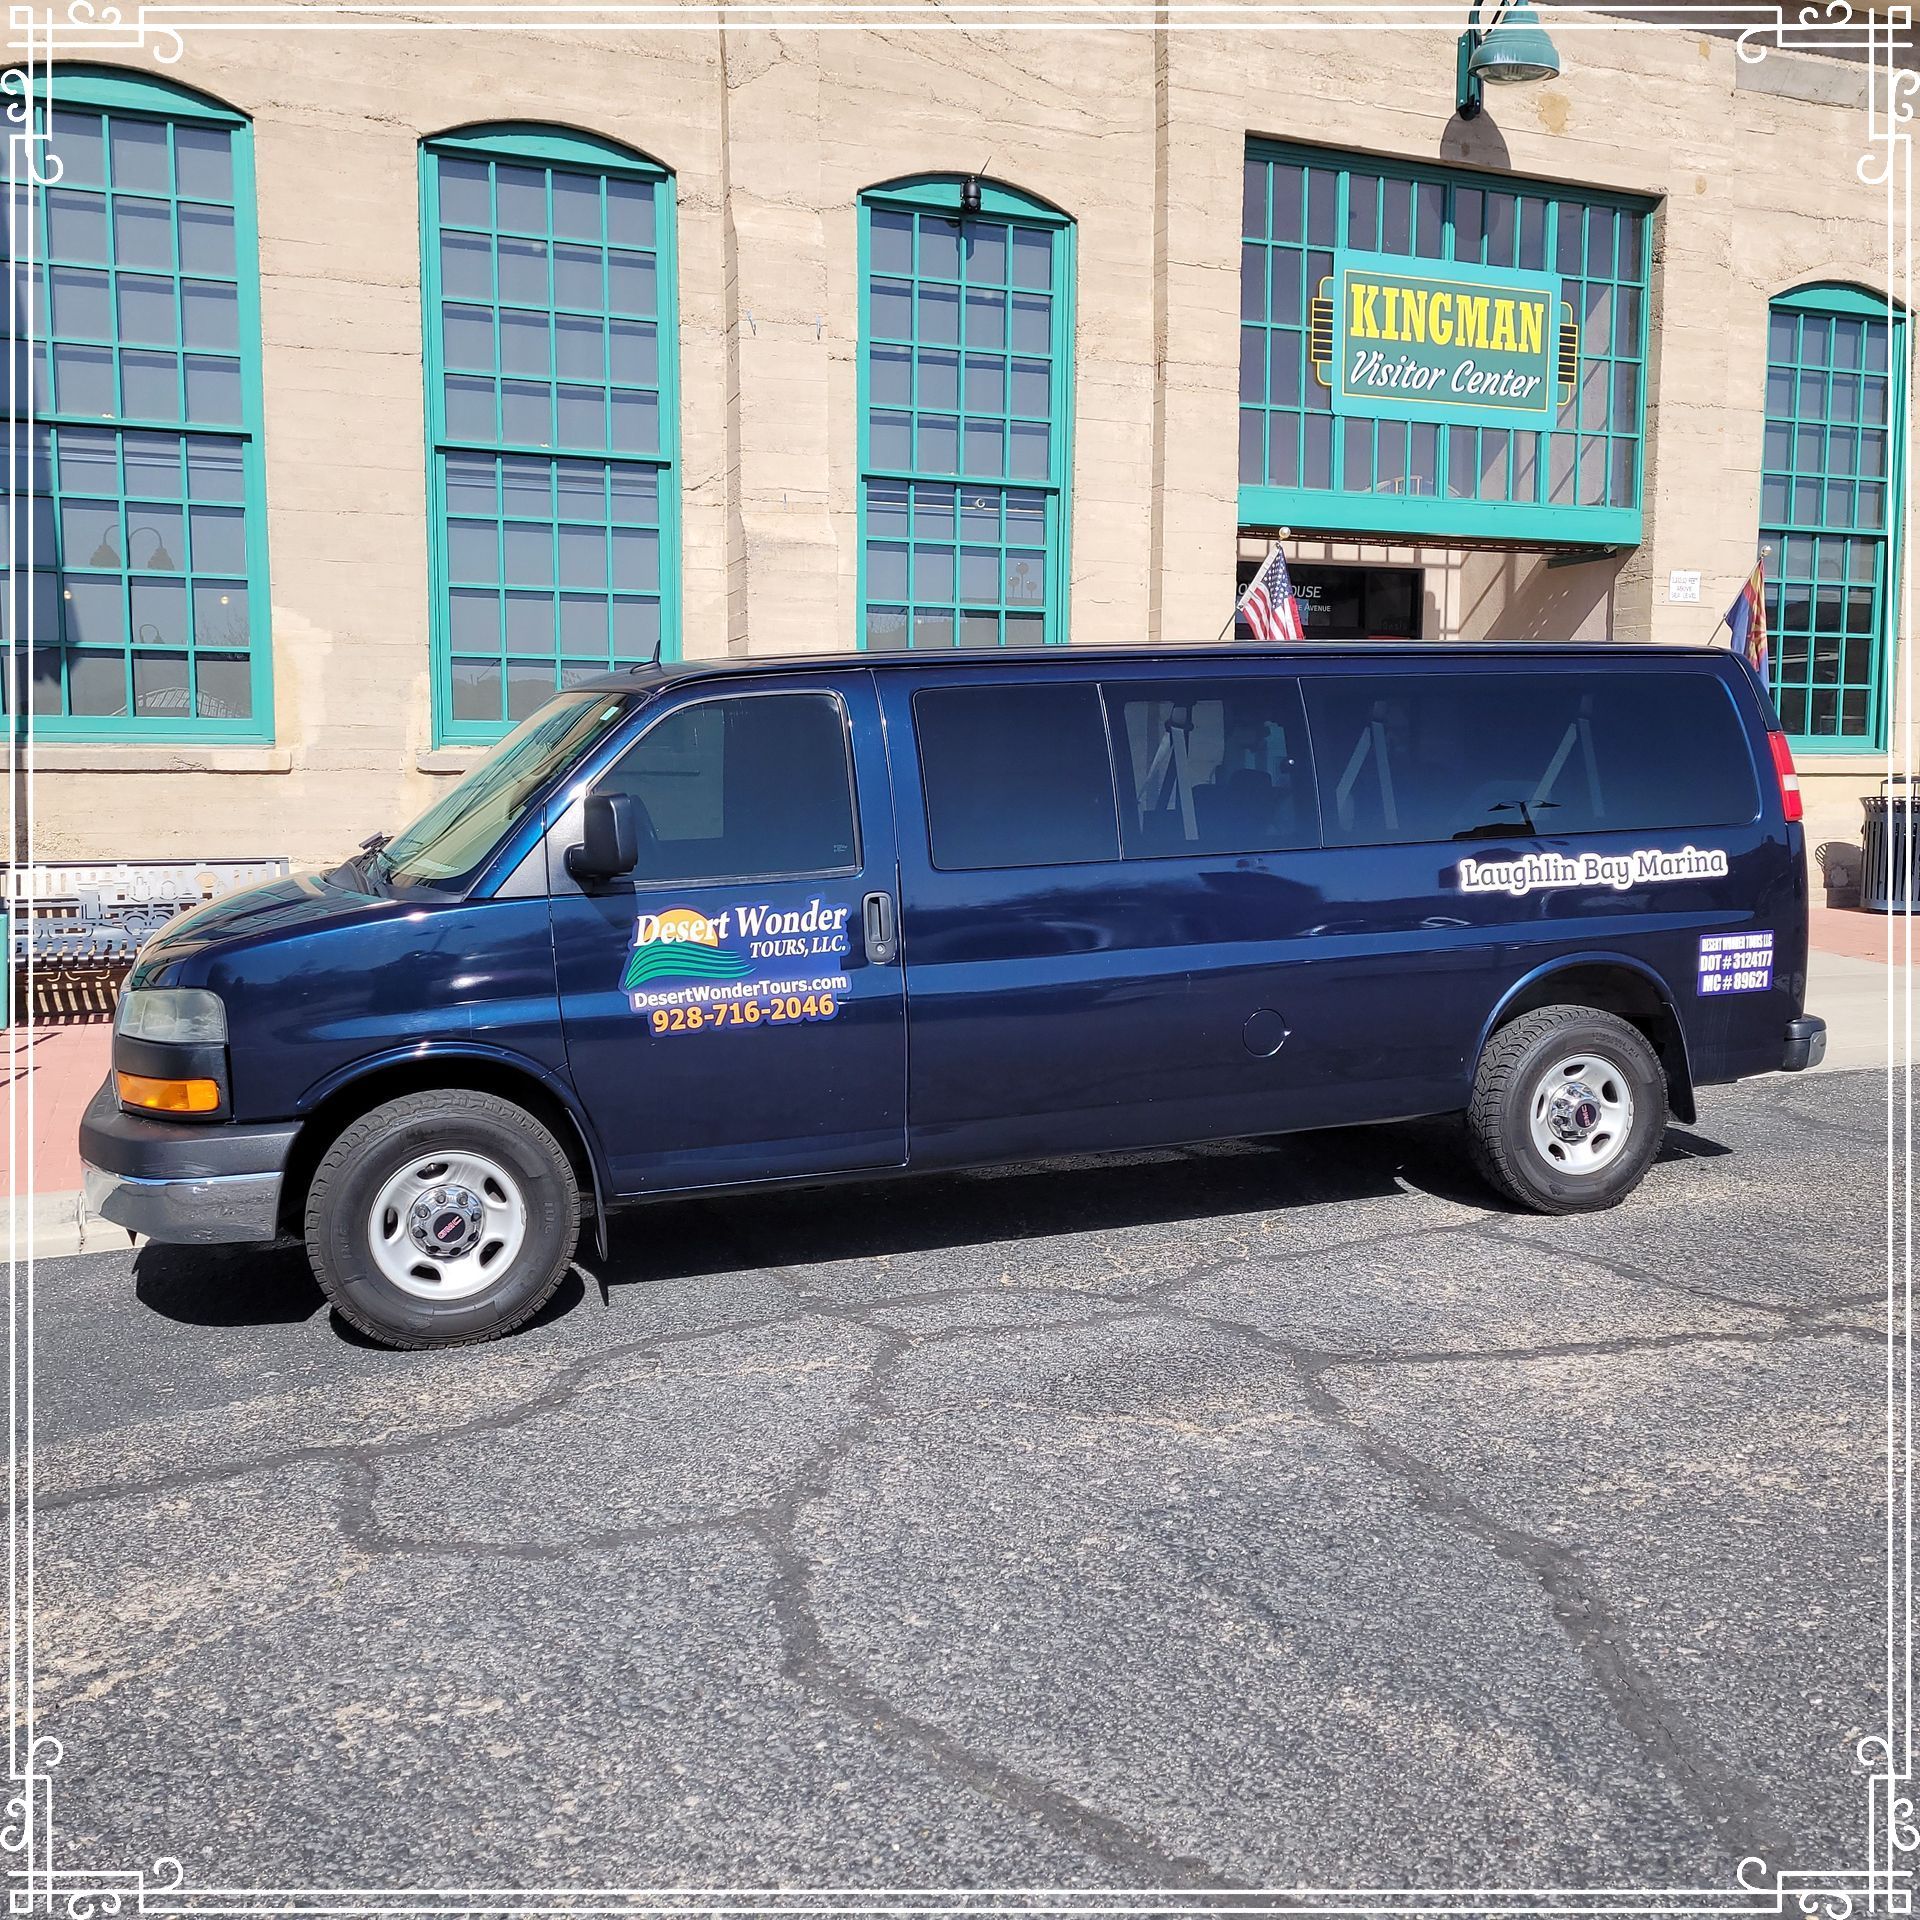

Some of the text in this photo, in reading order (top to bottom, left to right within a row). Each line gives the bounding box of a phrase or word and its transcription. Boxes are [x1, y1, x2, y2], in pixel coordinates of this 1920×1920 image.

[1350, 283, 1544, 353] KINGMAN
[1350, 350, 1541, 398] Visitor Center
[1304, 603, 1332, 612] AVENUE
[1464, 851, 1724, 890] Laughlin Bay Marina
[633, 898, 848, 947] Desert Wonder
[750, 935, 846, 959] TOURS, LLC.
[634, 976, 847, 1008] DesertWonderTours.com
[652, 993, 835, 1033] 928-716-2046
